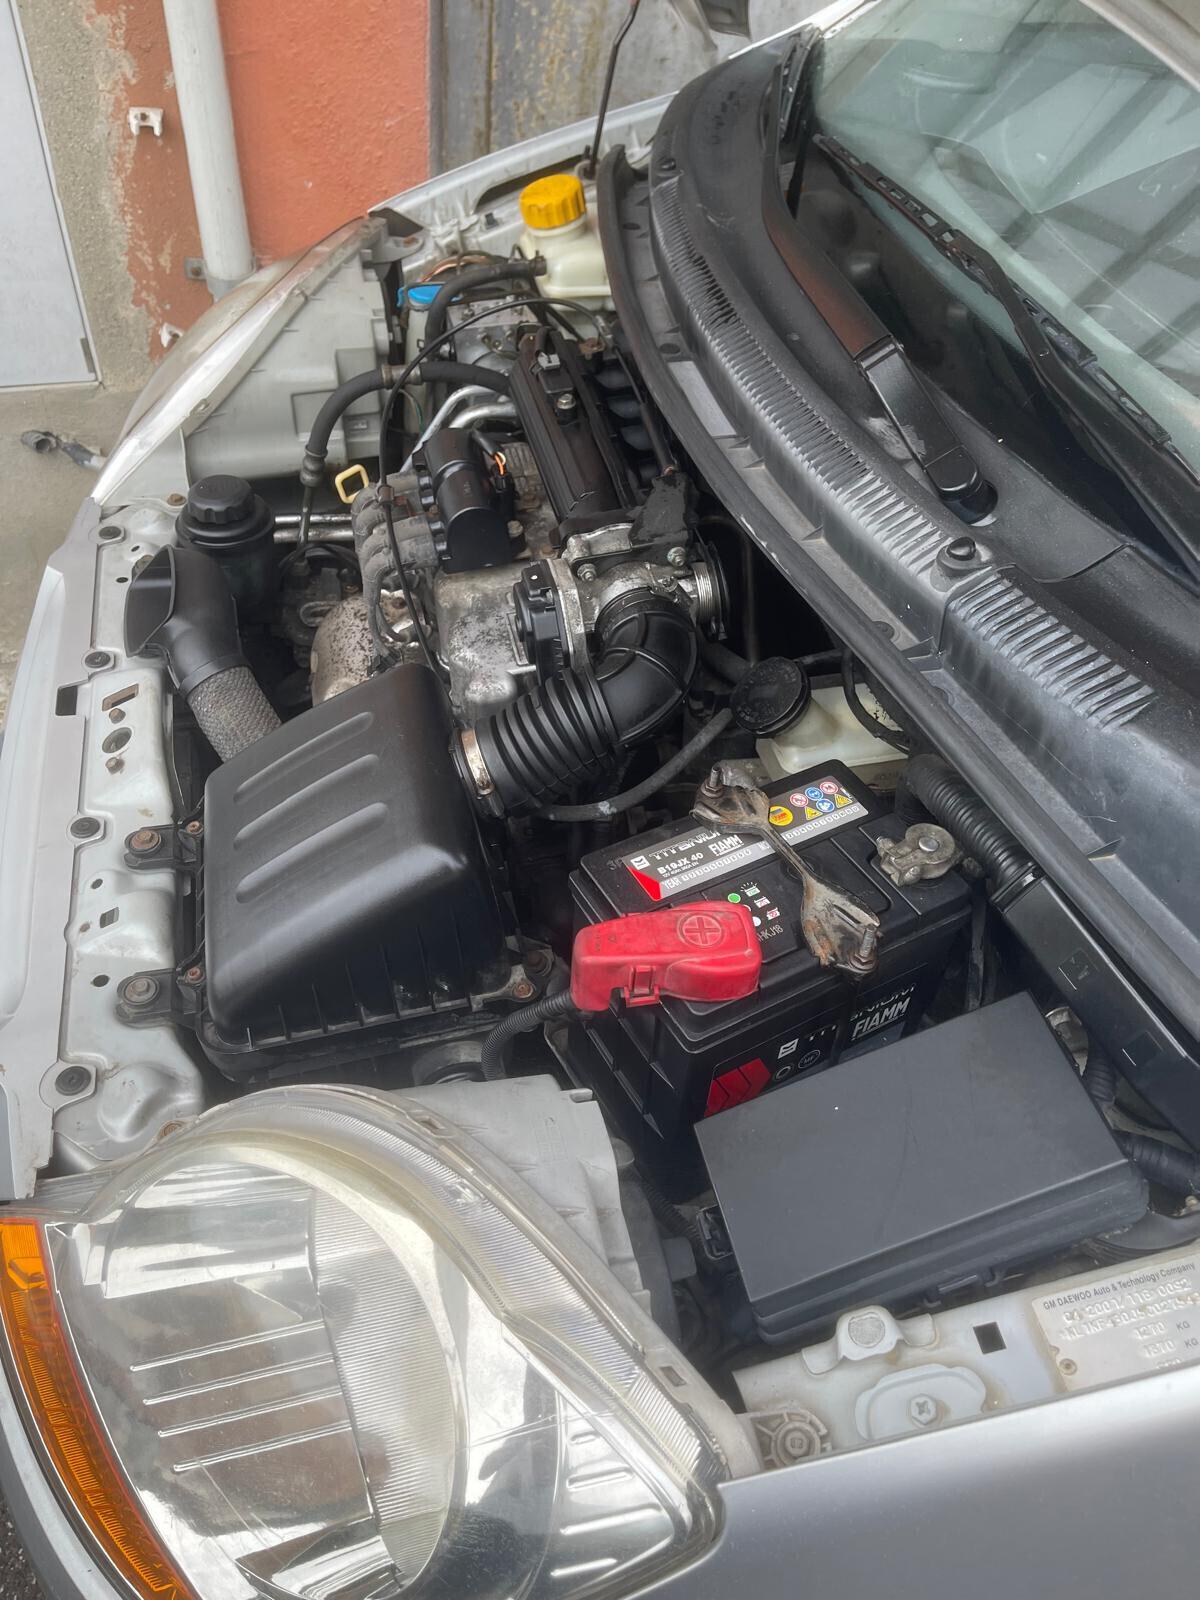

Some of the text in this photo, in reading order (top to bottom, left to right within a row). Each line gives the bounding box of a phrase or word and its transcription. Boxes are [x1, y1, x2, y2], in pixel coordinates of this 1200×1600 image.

[708, 834, 744, 856] FIAMM
[690, 852, 704, 862] 40
[664, 878, 682, 890] YEAR
[852, 996, 911, 1039] FIAMM
[1043, 1262, 1196, 1311] GM DAEWOO Auto & Technology Company
[1176, 1320, 1191, 1332] KG
[1184, 1337, 1199, 1349] KG
